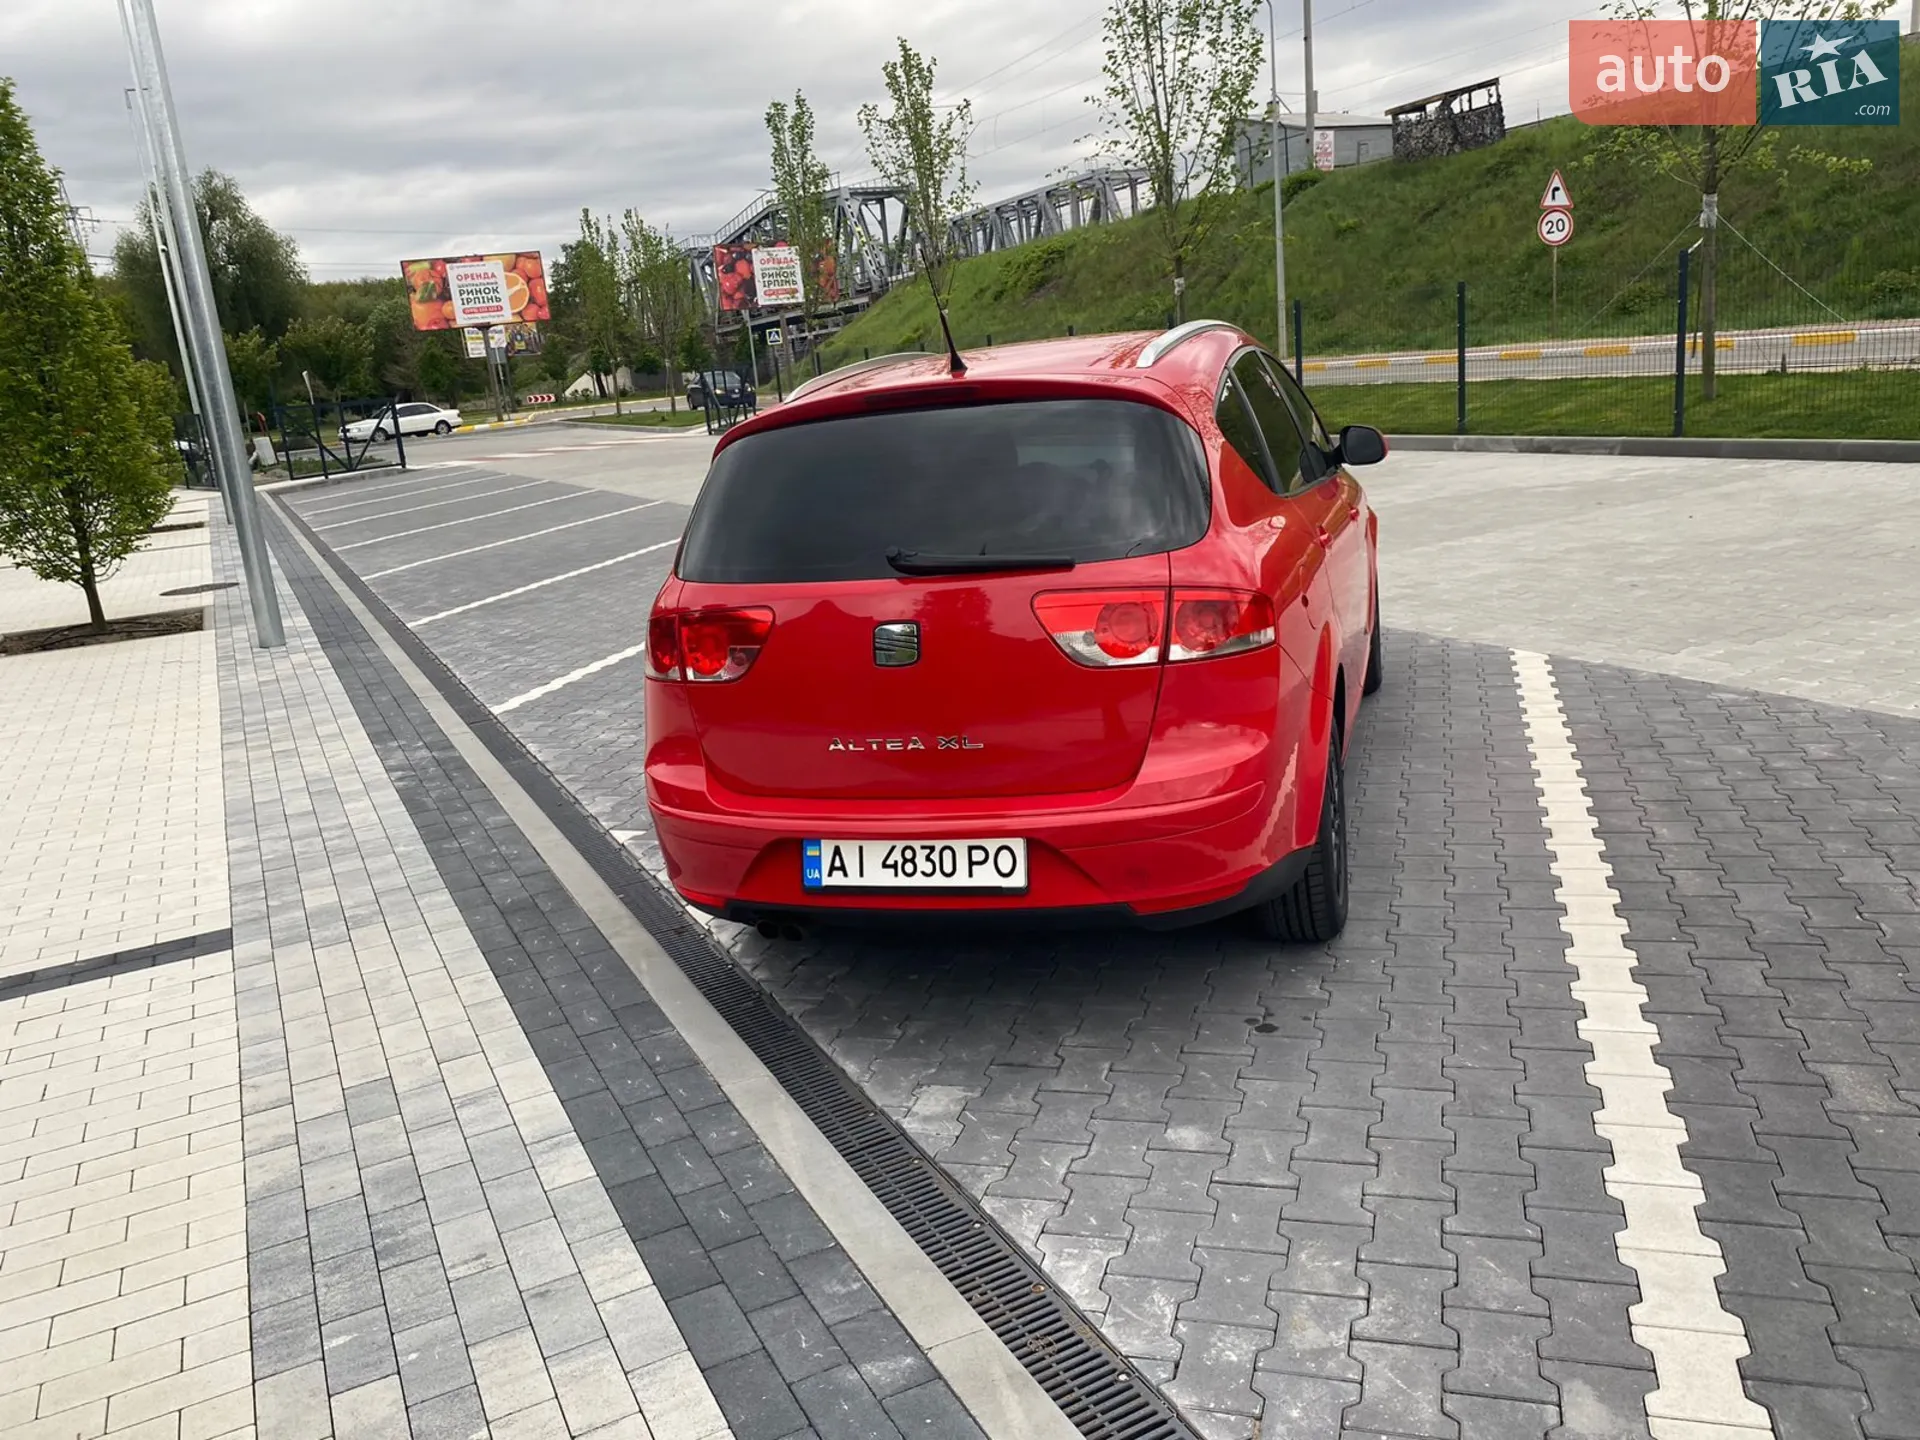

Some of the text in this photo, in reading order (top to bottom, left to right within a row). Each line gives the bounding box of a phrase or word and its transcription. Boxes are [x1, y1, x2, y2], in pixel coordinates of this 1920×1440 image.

[1545, 218, 1565, 235] 20
[456, 272, 497, 281] ОРЕНДА
[761, 271, 797, 279] РИНОК
[763, 279, 797, 288] ІРПІНЬ
[459, 286, 499, 296] РИНОК
[461, 295, 502, 305] ІРПІНЬ
[828, 736, 984, 751] ALTEA XL
[827, 845, 1018, 878] AI 4830 PO
[806, 869, 820, 879] UA
